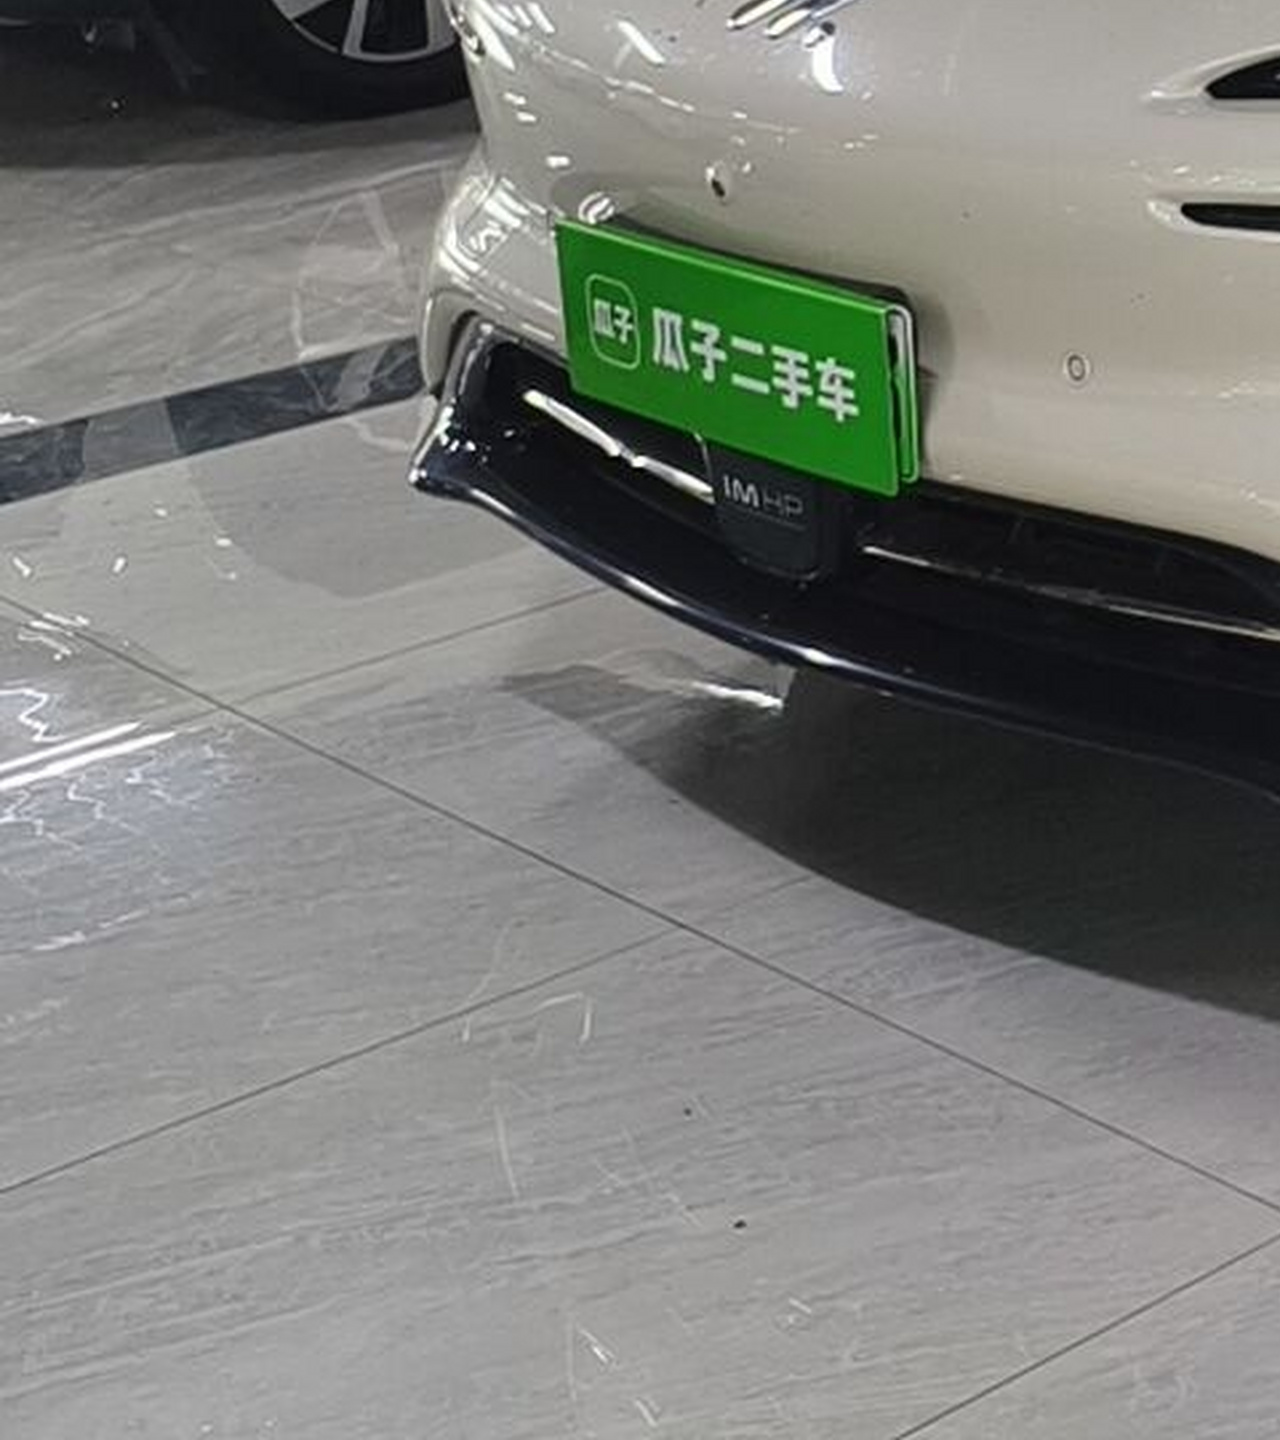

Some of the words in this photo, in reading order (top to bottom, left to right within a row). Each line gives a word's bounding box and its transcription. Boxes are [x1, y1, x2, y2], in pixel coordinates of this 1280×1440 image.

[593, 298, 634, 344] 瓜子
[652, 307, 860, 423] 瓜子二手车
